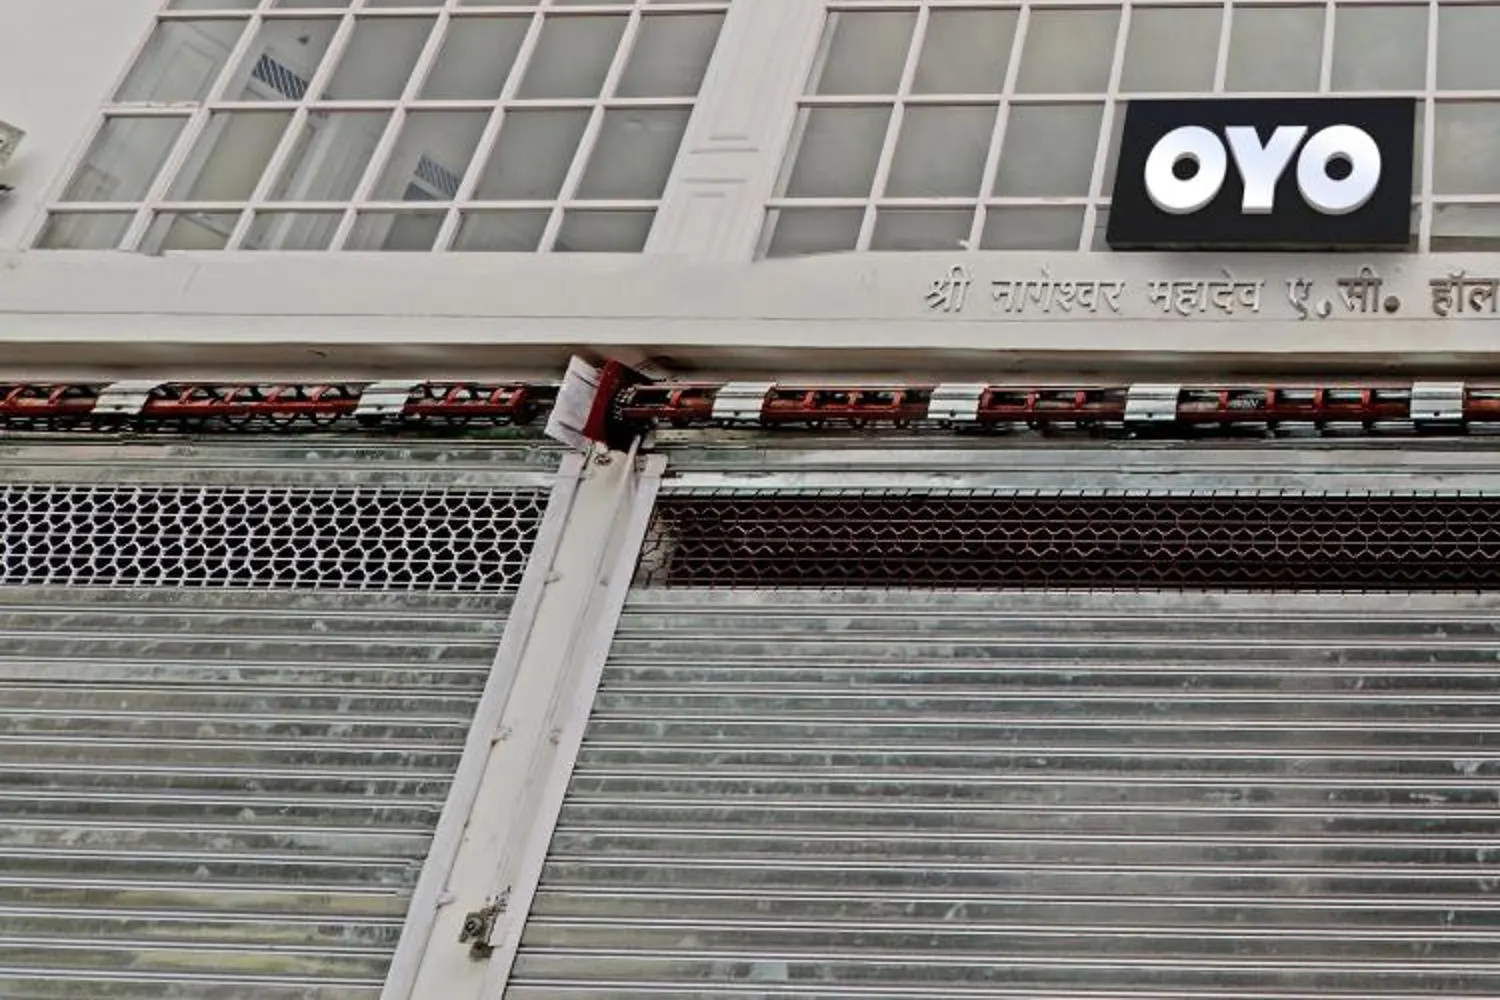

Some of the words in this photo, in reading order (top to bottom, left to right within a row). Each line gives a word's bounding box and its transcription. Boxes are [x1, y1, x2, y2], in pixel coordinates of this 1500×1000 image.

[1144, 123, 1382, 215] OYO
[925, 264, 971, 313] श्री
[1148, 267, 1265, 316] महादेव
[1429, 270, 1500, 316] हॉल
